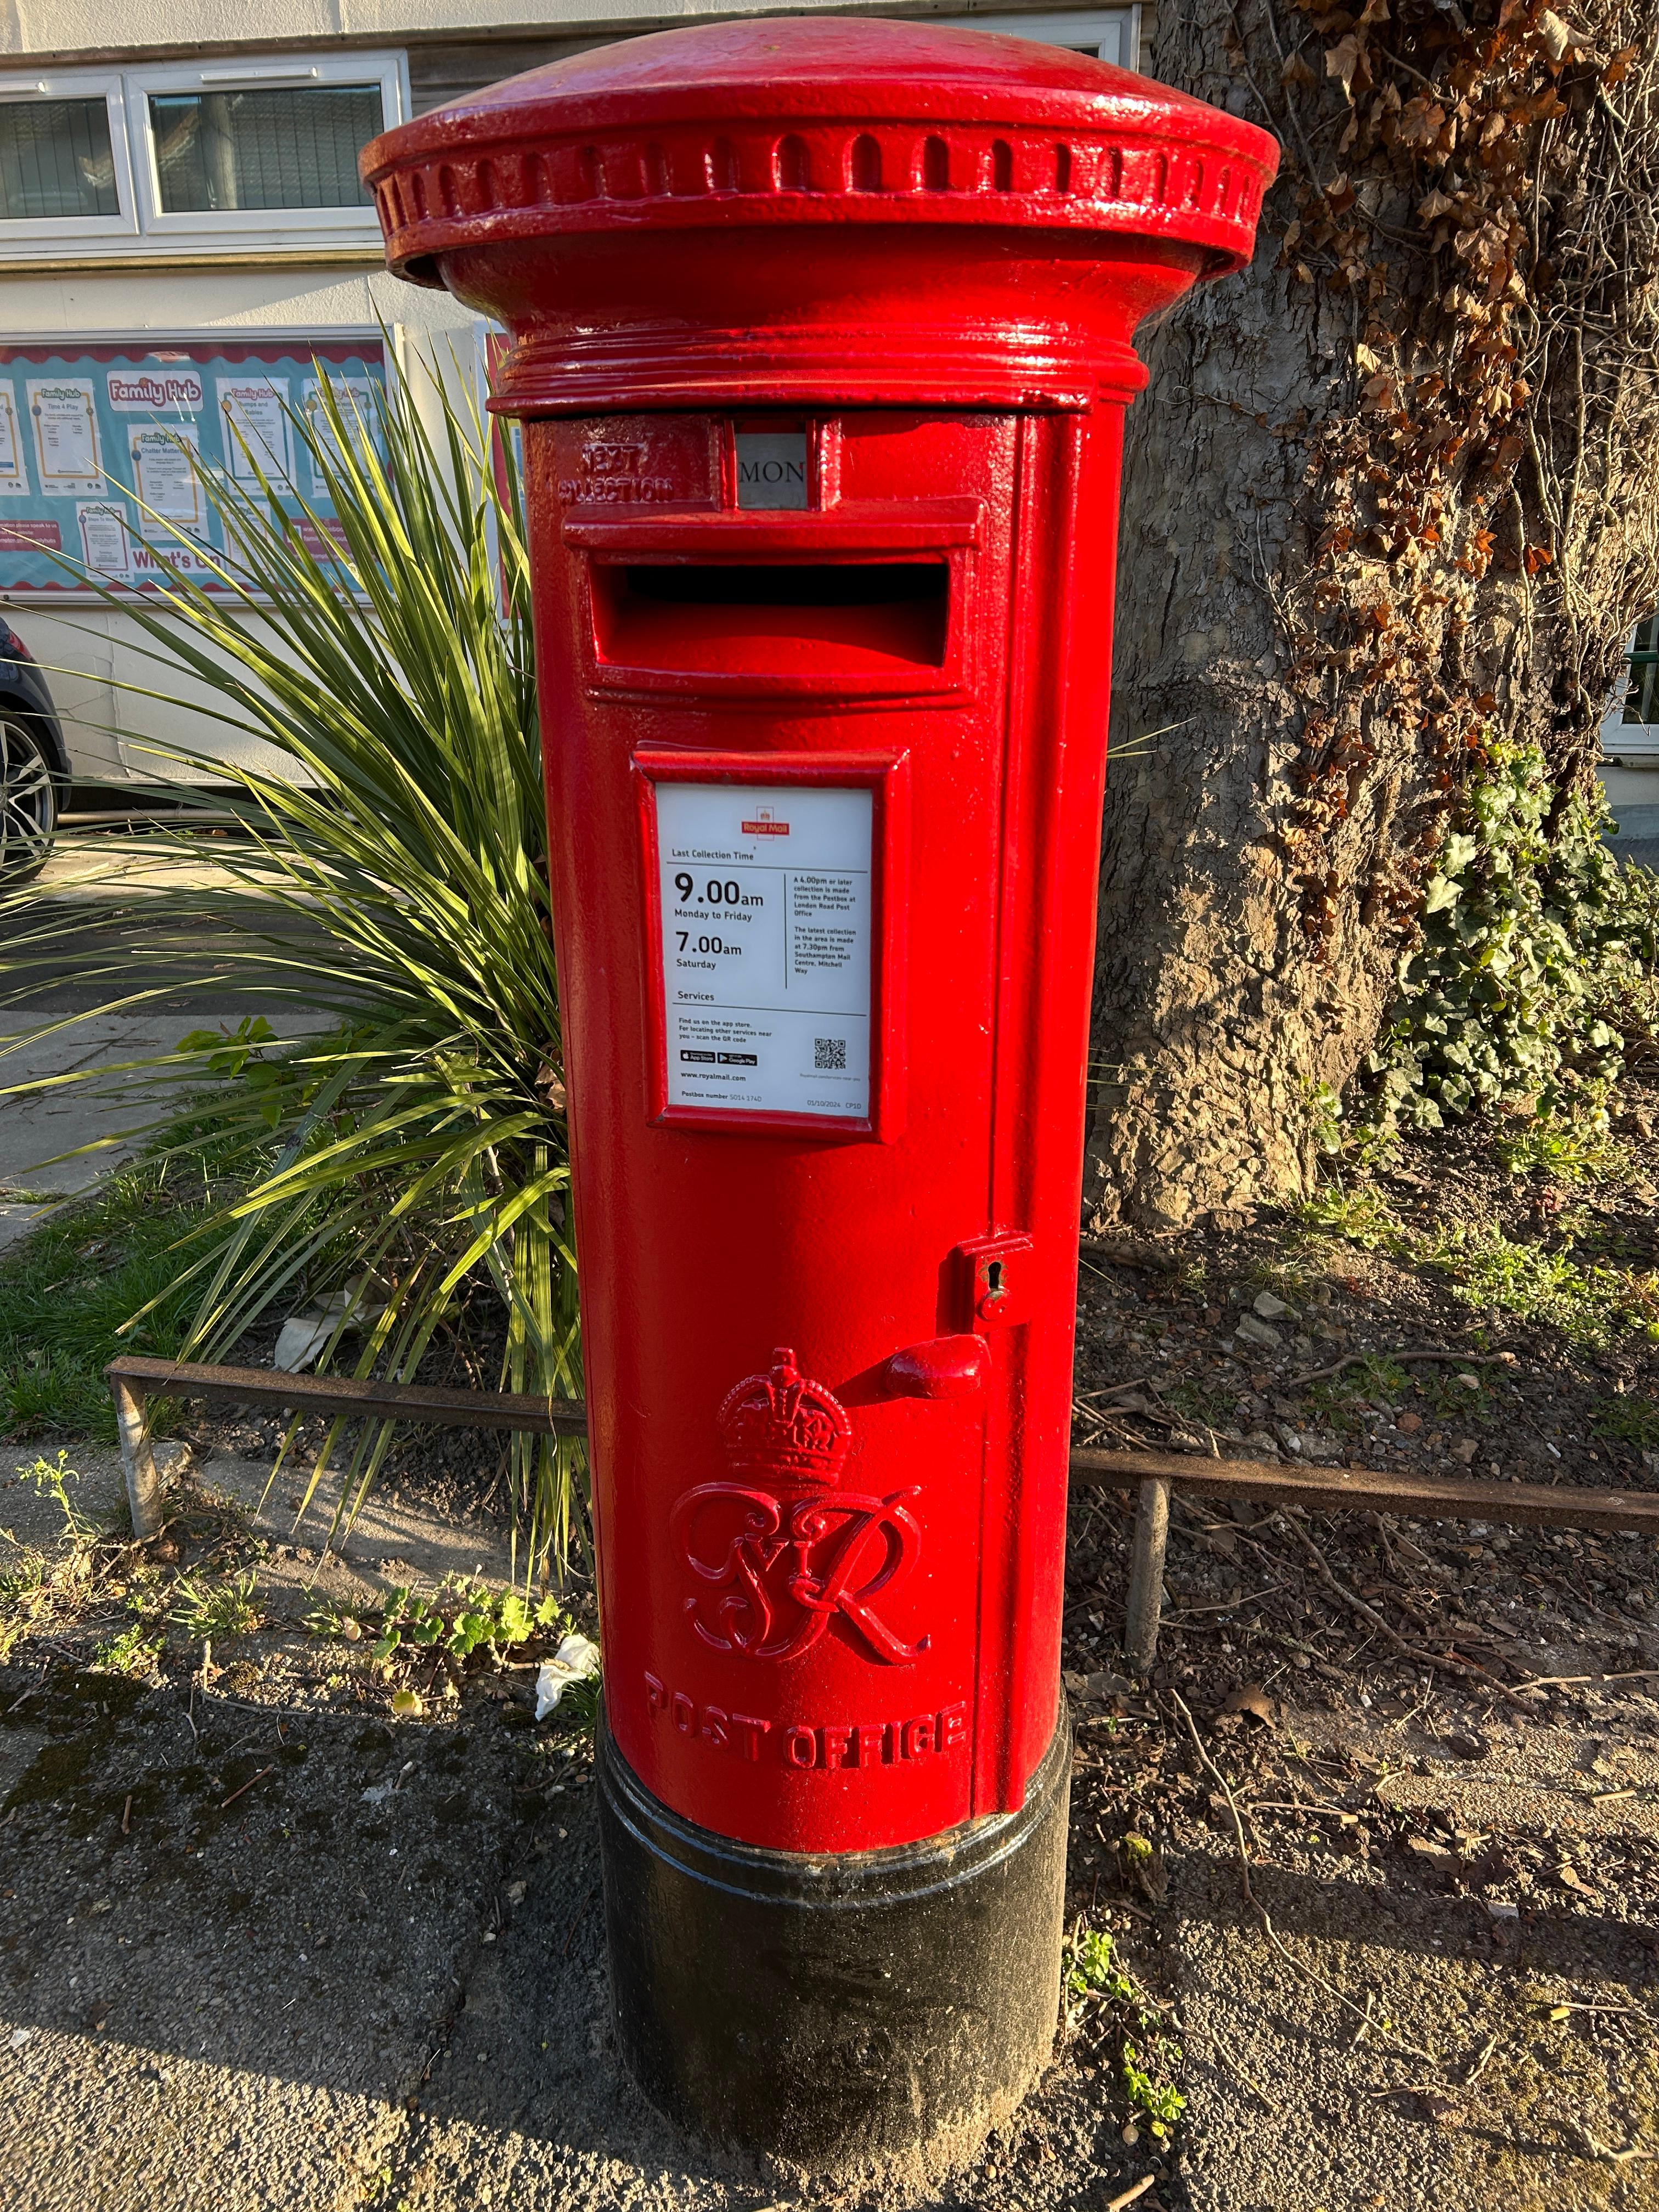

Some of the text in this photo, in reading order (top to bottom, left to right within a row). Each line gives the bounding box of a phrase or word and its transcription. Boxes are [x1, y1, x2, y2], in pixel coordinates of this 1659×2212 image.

[42, 388, 81, 400] Family Hub
[110, 378, 201, 407] Family Hub
[232, 387, 274, 400] Family Hub
[141, 433, 166, 445] Family
[739, 460, 805, 484] MON
[744, 822, 787, 833] Royal Mail
[672, 849, 754, 861] Last Collection Time
[800, 876, 827, 885] 4.00pm
[675, 872, 764, 906] 9.00am
[674, 907, 752, 922] Monday to Friday
[676, 931, 742, 956] 7.00am
[803, 943, 827, 951] 7.30pm
[795, 952, 836, 961] Southampton
[676, 958, 716, 970] Saturday
[678, 991, 715, 1001] Services
[681, 1072, 746, 1082] www.royalmail.com
[644, 1670, 968, 1769] POST OFFICE
